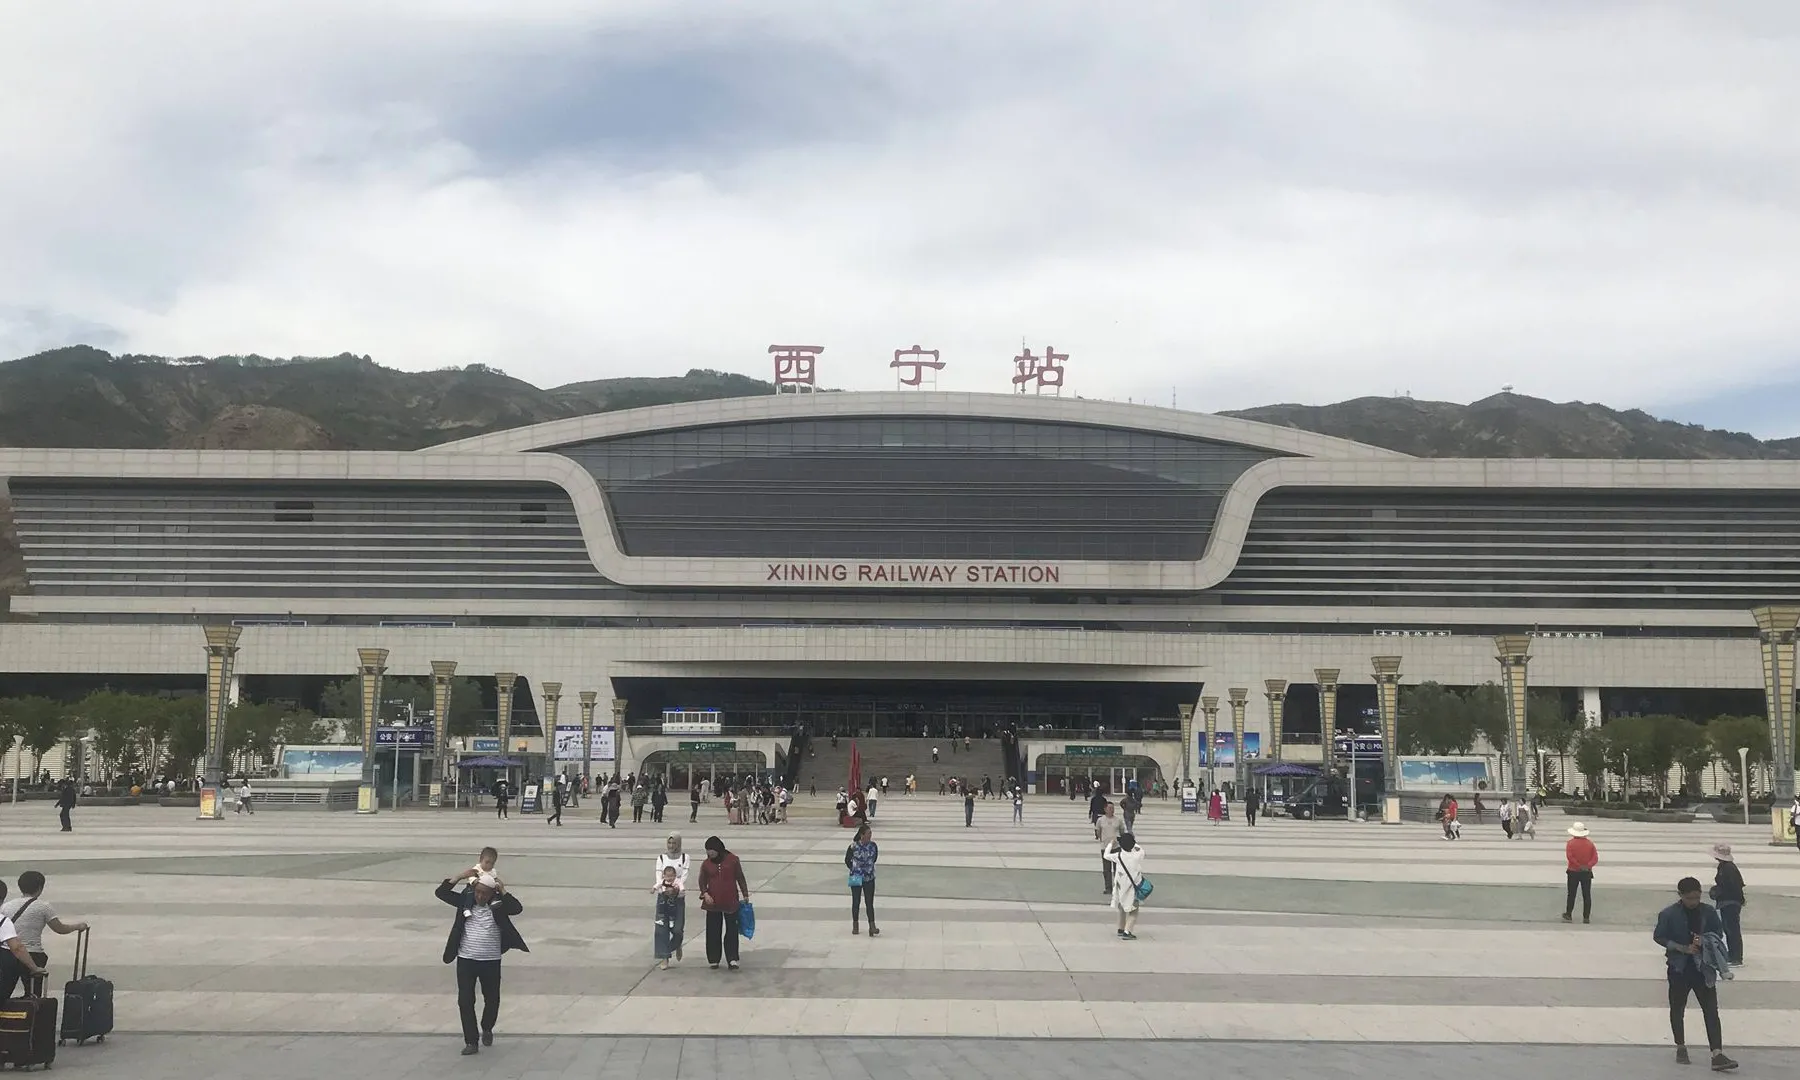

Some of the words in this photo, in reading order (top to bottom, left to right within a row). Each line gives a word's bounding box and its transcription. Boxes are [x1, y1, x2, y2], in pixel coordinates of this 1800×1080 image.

[768, 344, 1069, 387] 西宁站
[766, 564, 847, 581] XINING
[858, 564, 958, 583] RAILWAY
[967, 565, 1060, 583] STATION
